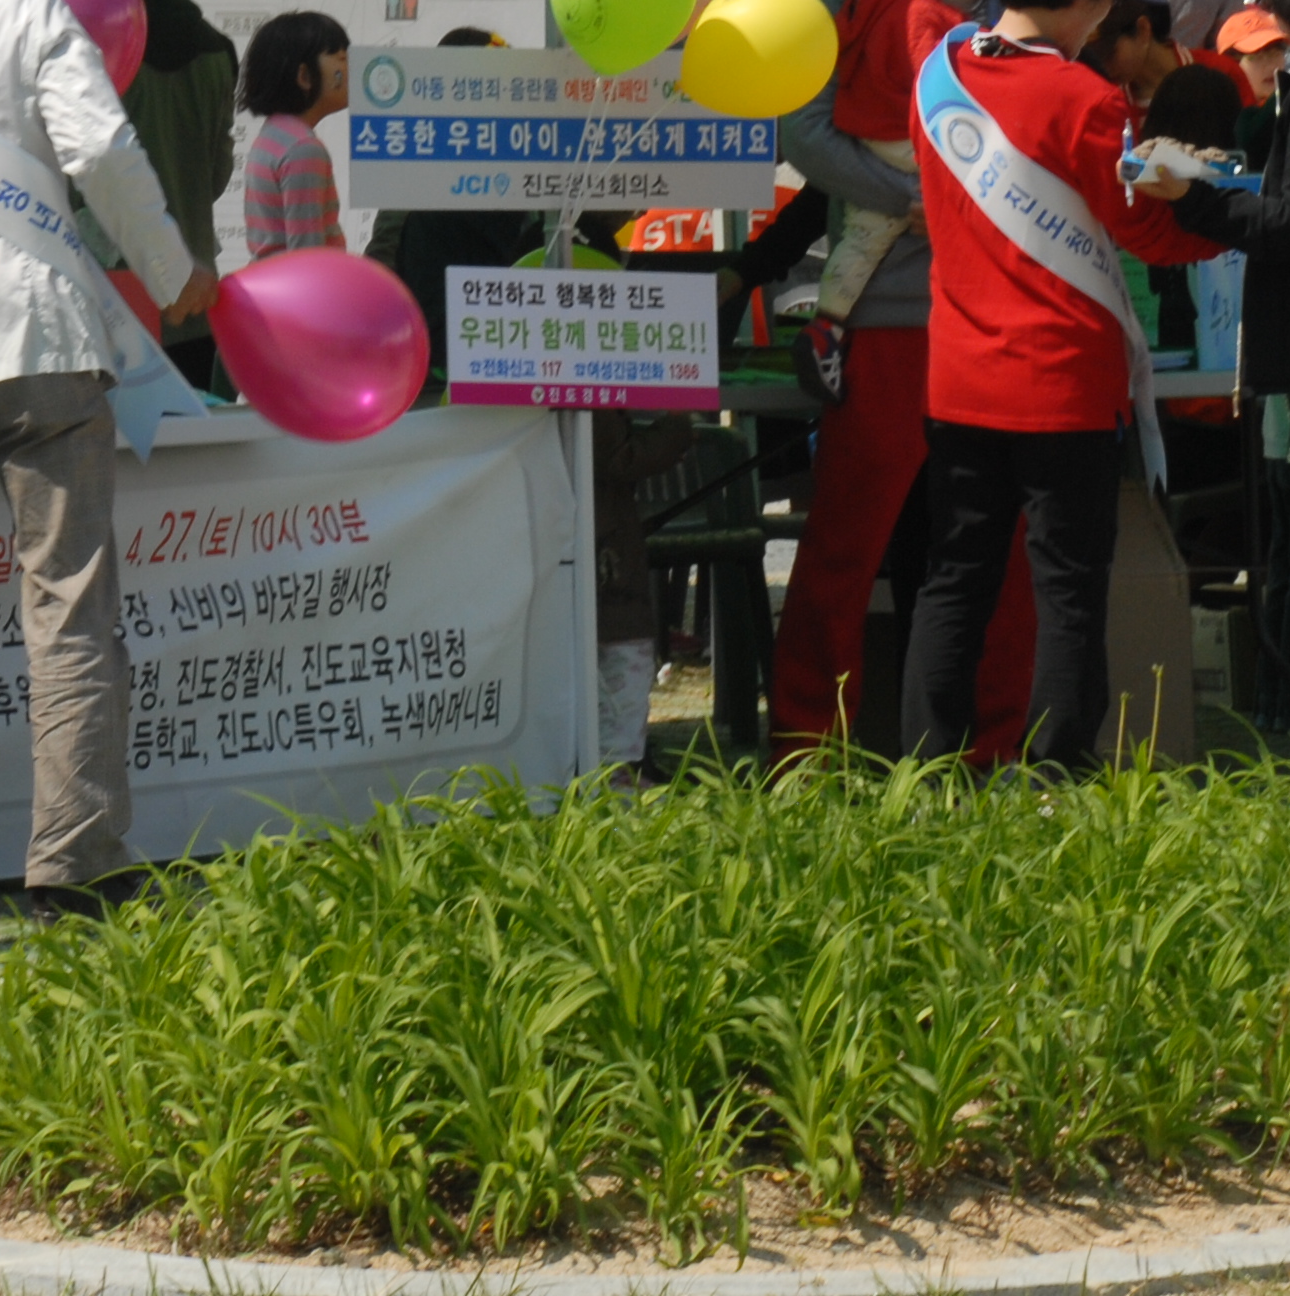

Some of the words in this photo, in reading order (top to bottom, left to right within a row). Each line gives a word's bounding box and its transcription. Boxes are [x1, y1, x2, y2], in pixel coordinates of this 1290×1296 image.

[412, 76, 445, 101] 아동
[564, 78, 595, 102] 예방
[354, 121, 436, 157] 소중한
[447, 122, 497, 157] 우리
[510, 122, 573, 157] 아이,
[584, 122, 685, 158] 안전하게
[695, 123, 770, 156] 지켜요
[450, 174, 492, 196] JCI
[462, 280, 546, 306] 안전하고
[556, 282, 617, 309] 행복한
[626, 284, 666, 310] 진도
[460, 317, 529, 350] 우리가
[542, 319, 586, 351] 함께
[597, 320, 707, 354] 만들어요!!
[541, 361, 563, 378] 117
[548, 387, 628, 405] 진도경찰서
[169, 579, 248, 633] 신비의
[254, 569, 323, 623] 바닷길
[328, 561, 392, 616] 행사장
[300, 626, 467, 693] 진도교육지원청
[379, 678, 503, 745] 녹색어머니회
